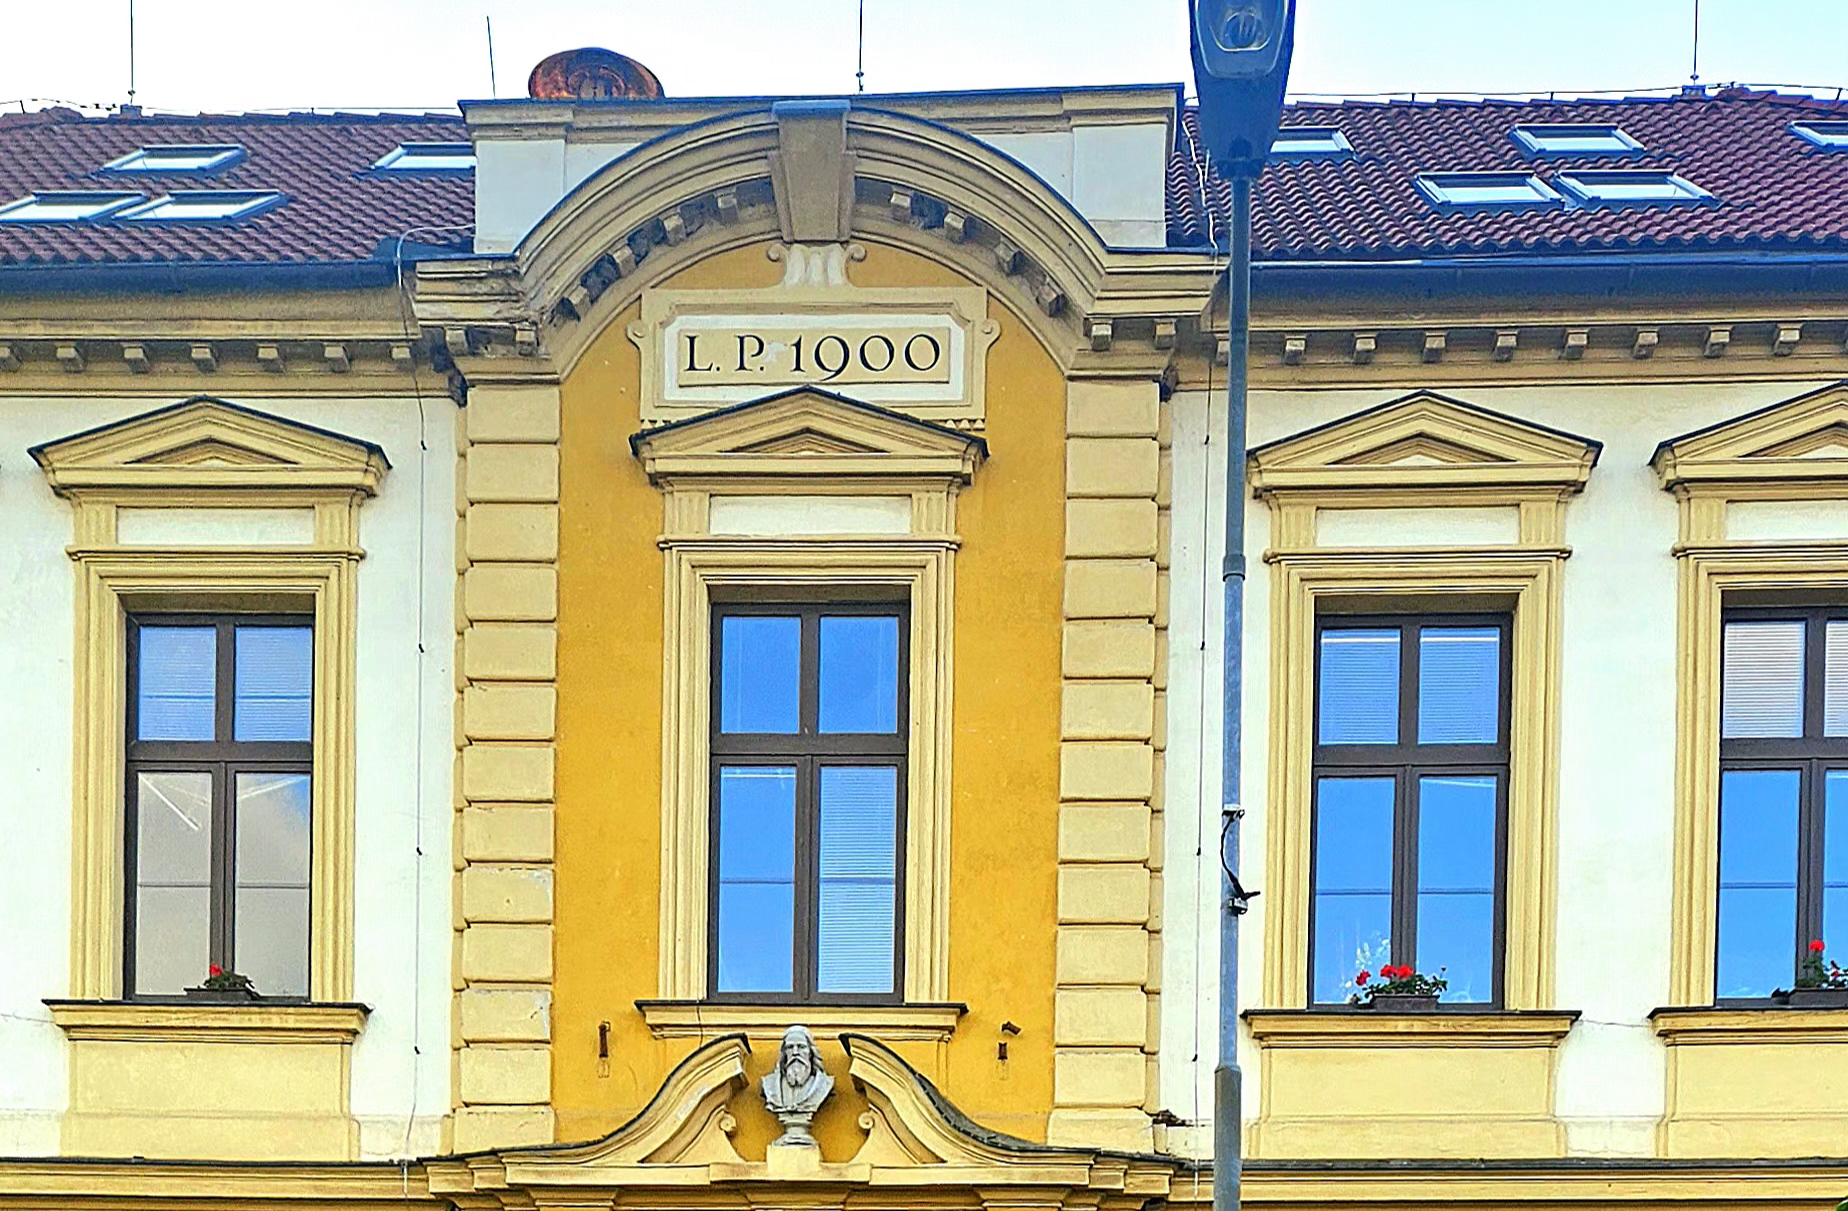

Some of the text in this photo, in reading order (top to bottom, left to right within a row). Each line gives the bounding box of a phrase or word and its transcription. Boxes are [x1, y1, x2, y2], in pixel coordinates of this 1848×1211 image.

[683, 333, 941, 382] L. P. 1900
